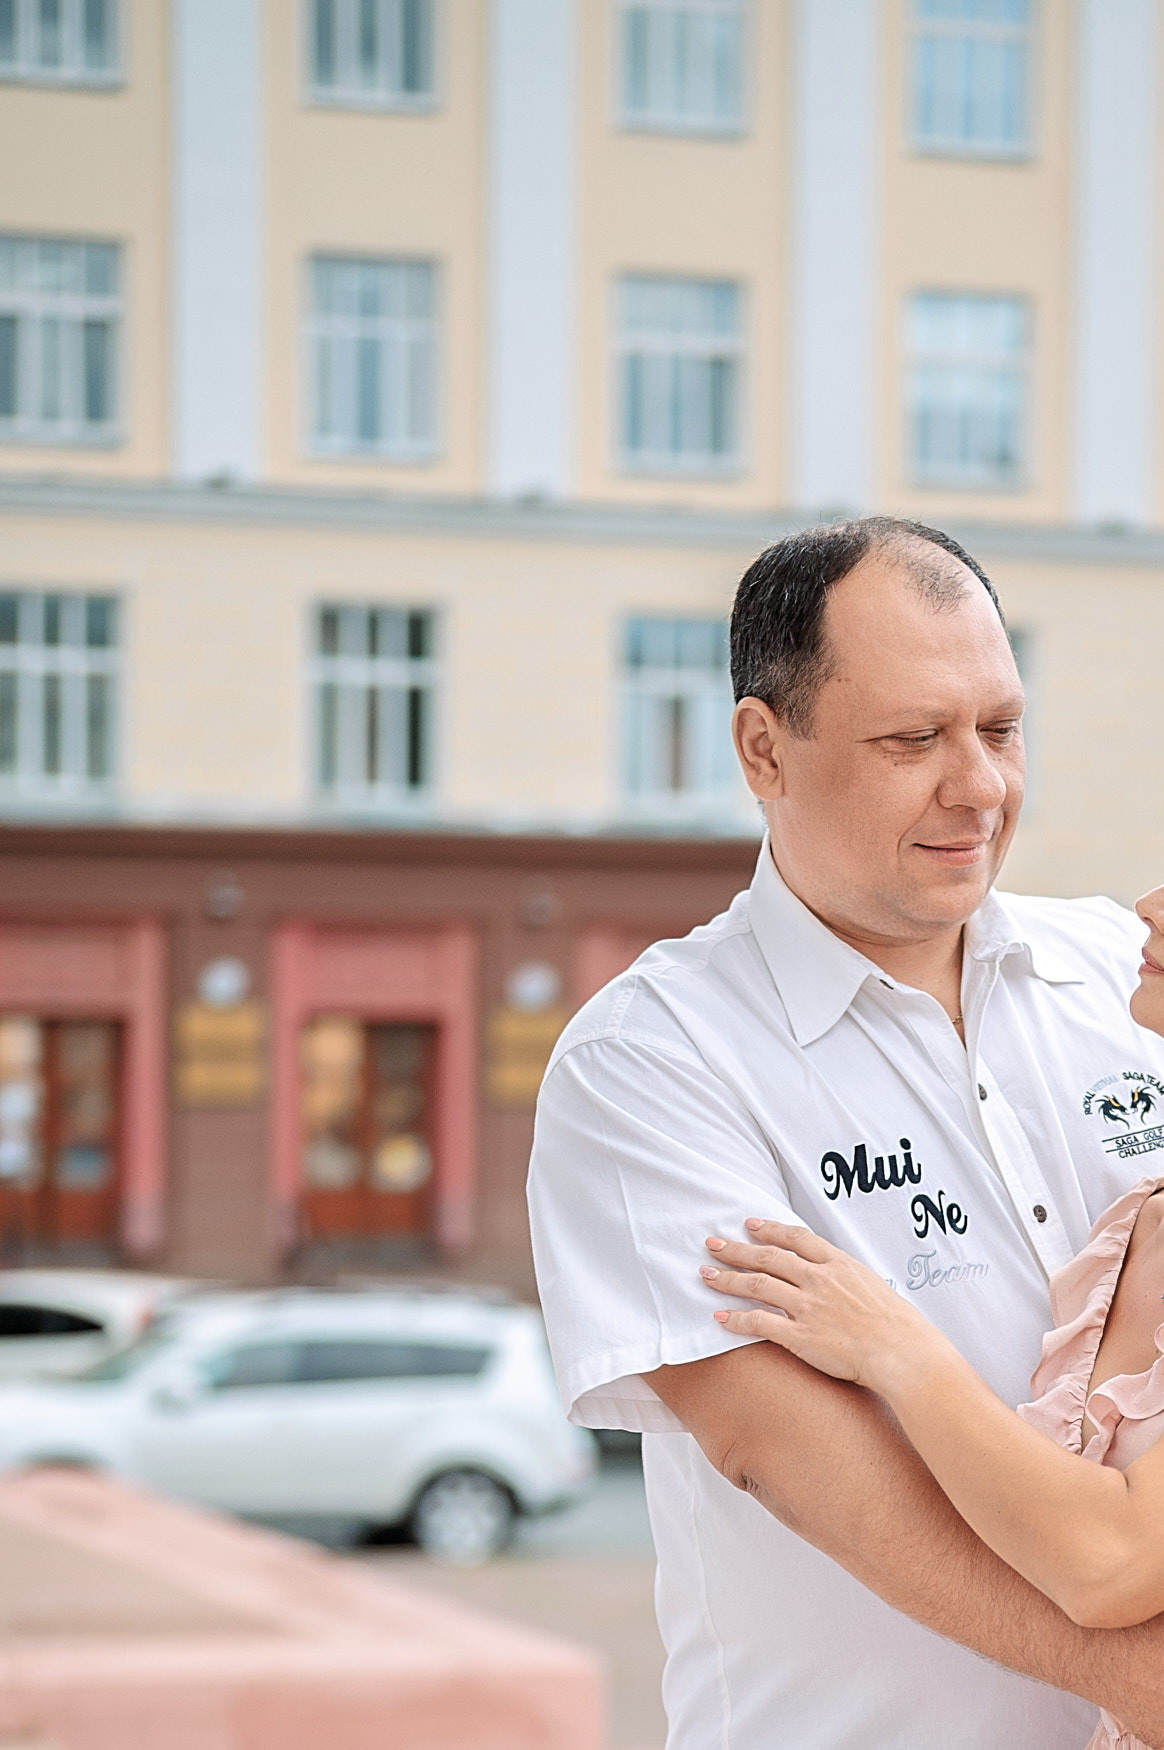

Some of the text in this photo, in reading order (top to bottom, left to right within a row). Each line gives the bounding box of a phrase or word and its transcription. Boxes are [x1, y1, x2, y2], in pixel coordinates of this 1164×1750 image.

[1122, 1071, 1146, 1083] SAGA
[1115, 1128, 1163, 1149] SAGA GOLF
[820, 1138, 922, 1200] Mui
[911, 1189, 968, 1239] Ne
[906, 1249, 989, 1291] Team
